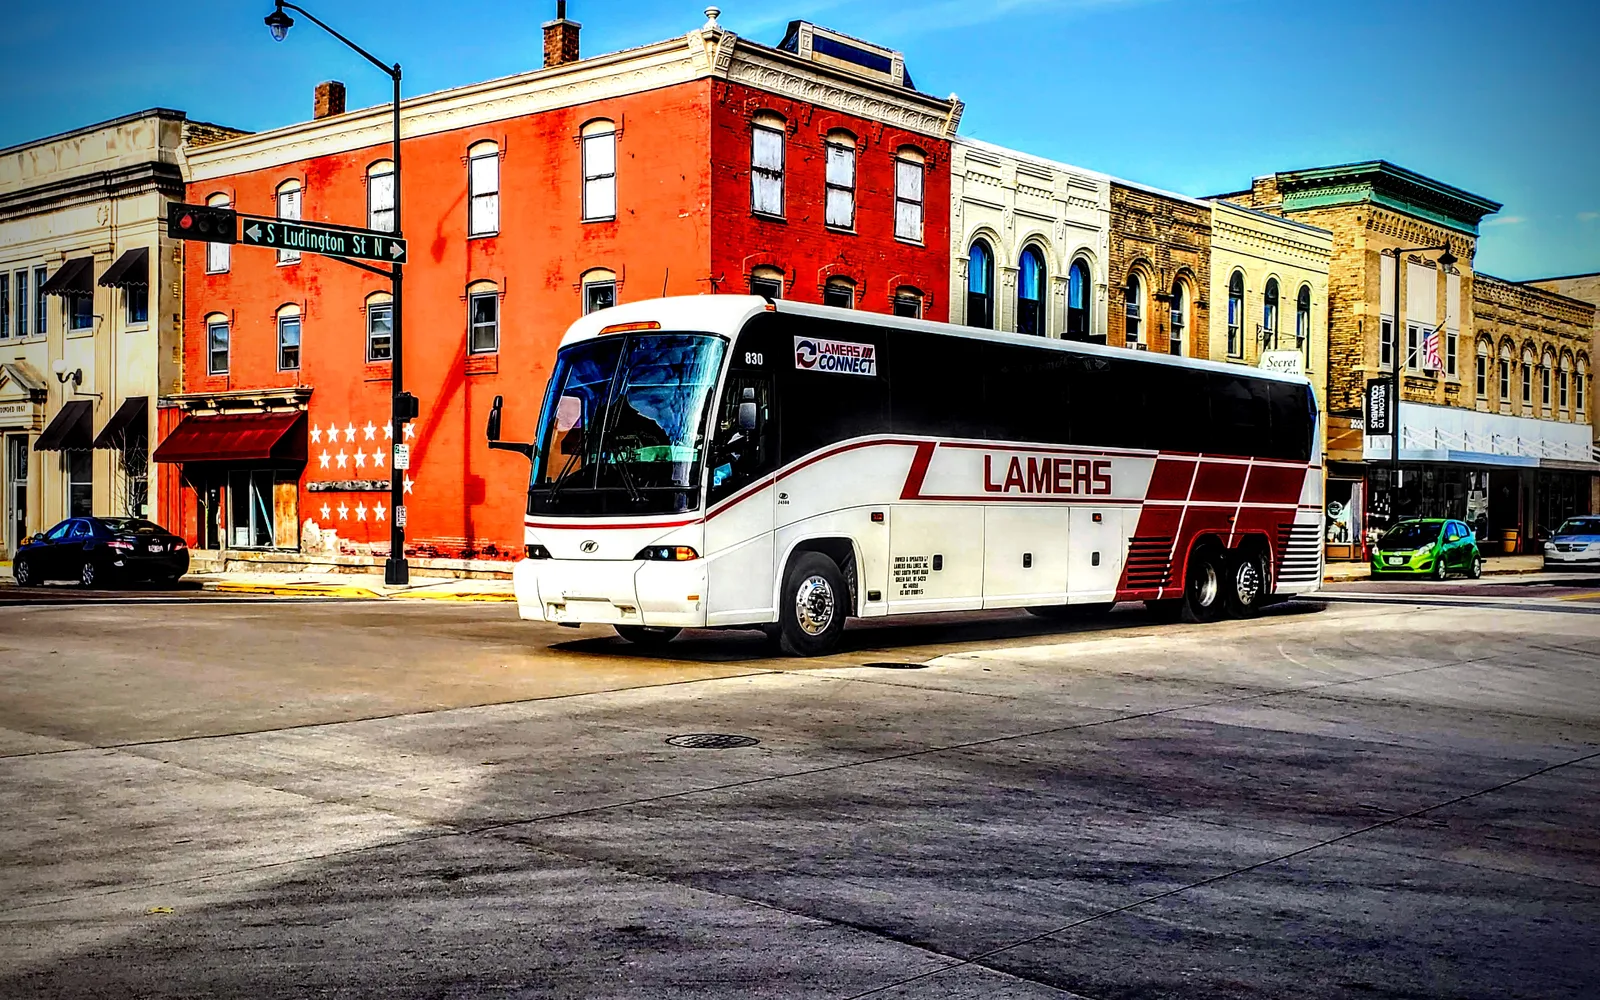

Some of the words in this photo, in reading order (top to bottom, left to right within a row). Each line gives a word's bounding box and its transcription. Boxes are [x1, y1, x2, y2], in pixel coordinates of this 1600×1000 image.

[266, 224, 275, 243] S
[284, 226, 345, 253] Ludington
[352, 235, 366, 255] St
[374, 238, 383, 257] N
[745, 352, 763, 365] 830
[817, 342, 861, 358] LAMERS
[819, 354, 874, 374] CONNECT
[1267, 356, 1297, 368] Secret
[1371, 385, 1379, 429] COLUMBUS
[1379, 419, 1384, 428] TO
[984, 454, 1112, 495] LAMERS
